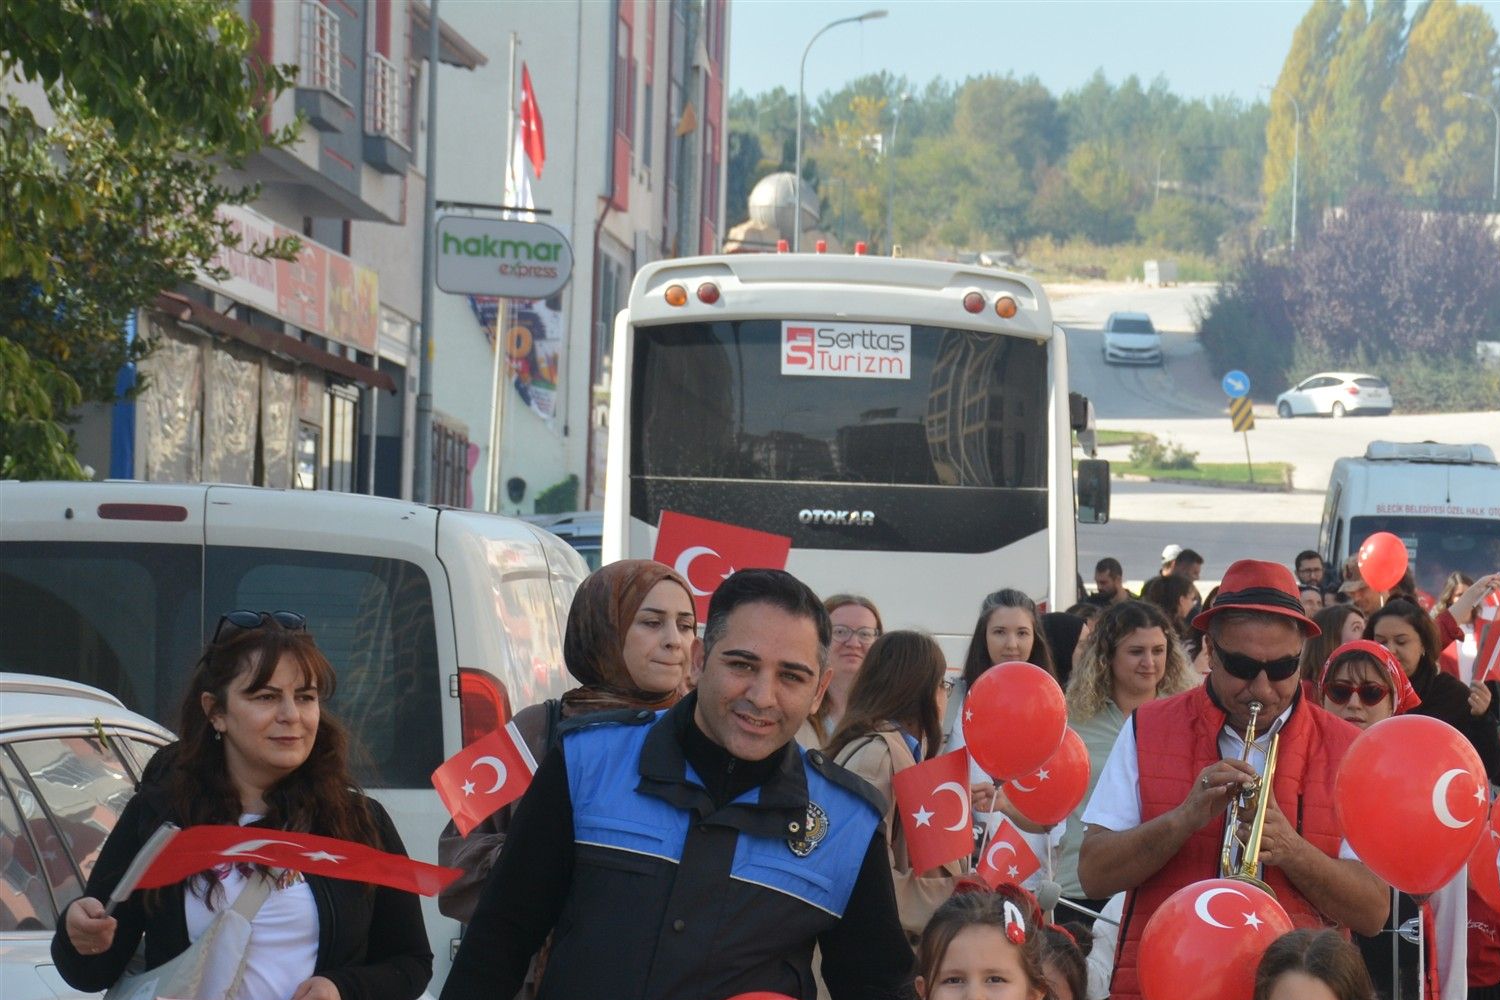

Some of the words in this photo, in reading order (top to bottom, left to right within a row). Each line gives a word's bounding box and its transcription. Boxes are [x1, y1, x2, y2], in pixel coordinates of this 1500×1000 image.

[443, 231, 563, 262] hakmar
[499, 261, 558, 279] express
[817, 328, 905, 353] Serttaş
[817, 350, 904, 375] Turizm
[798, 508, 875, 526] OTOKAR
